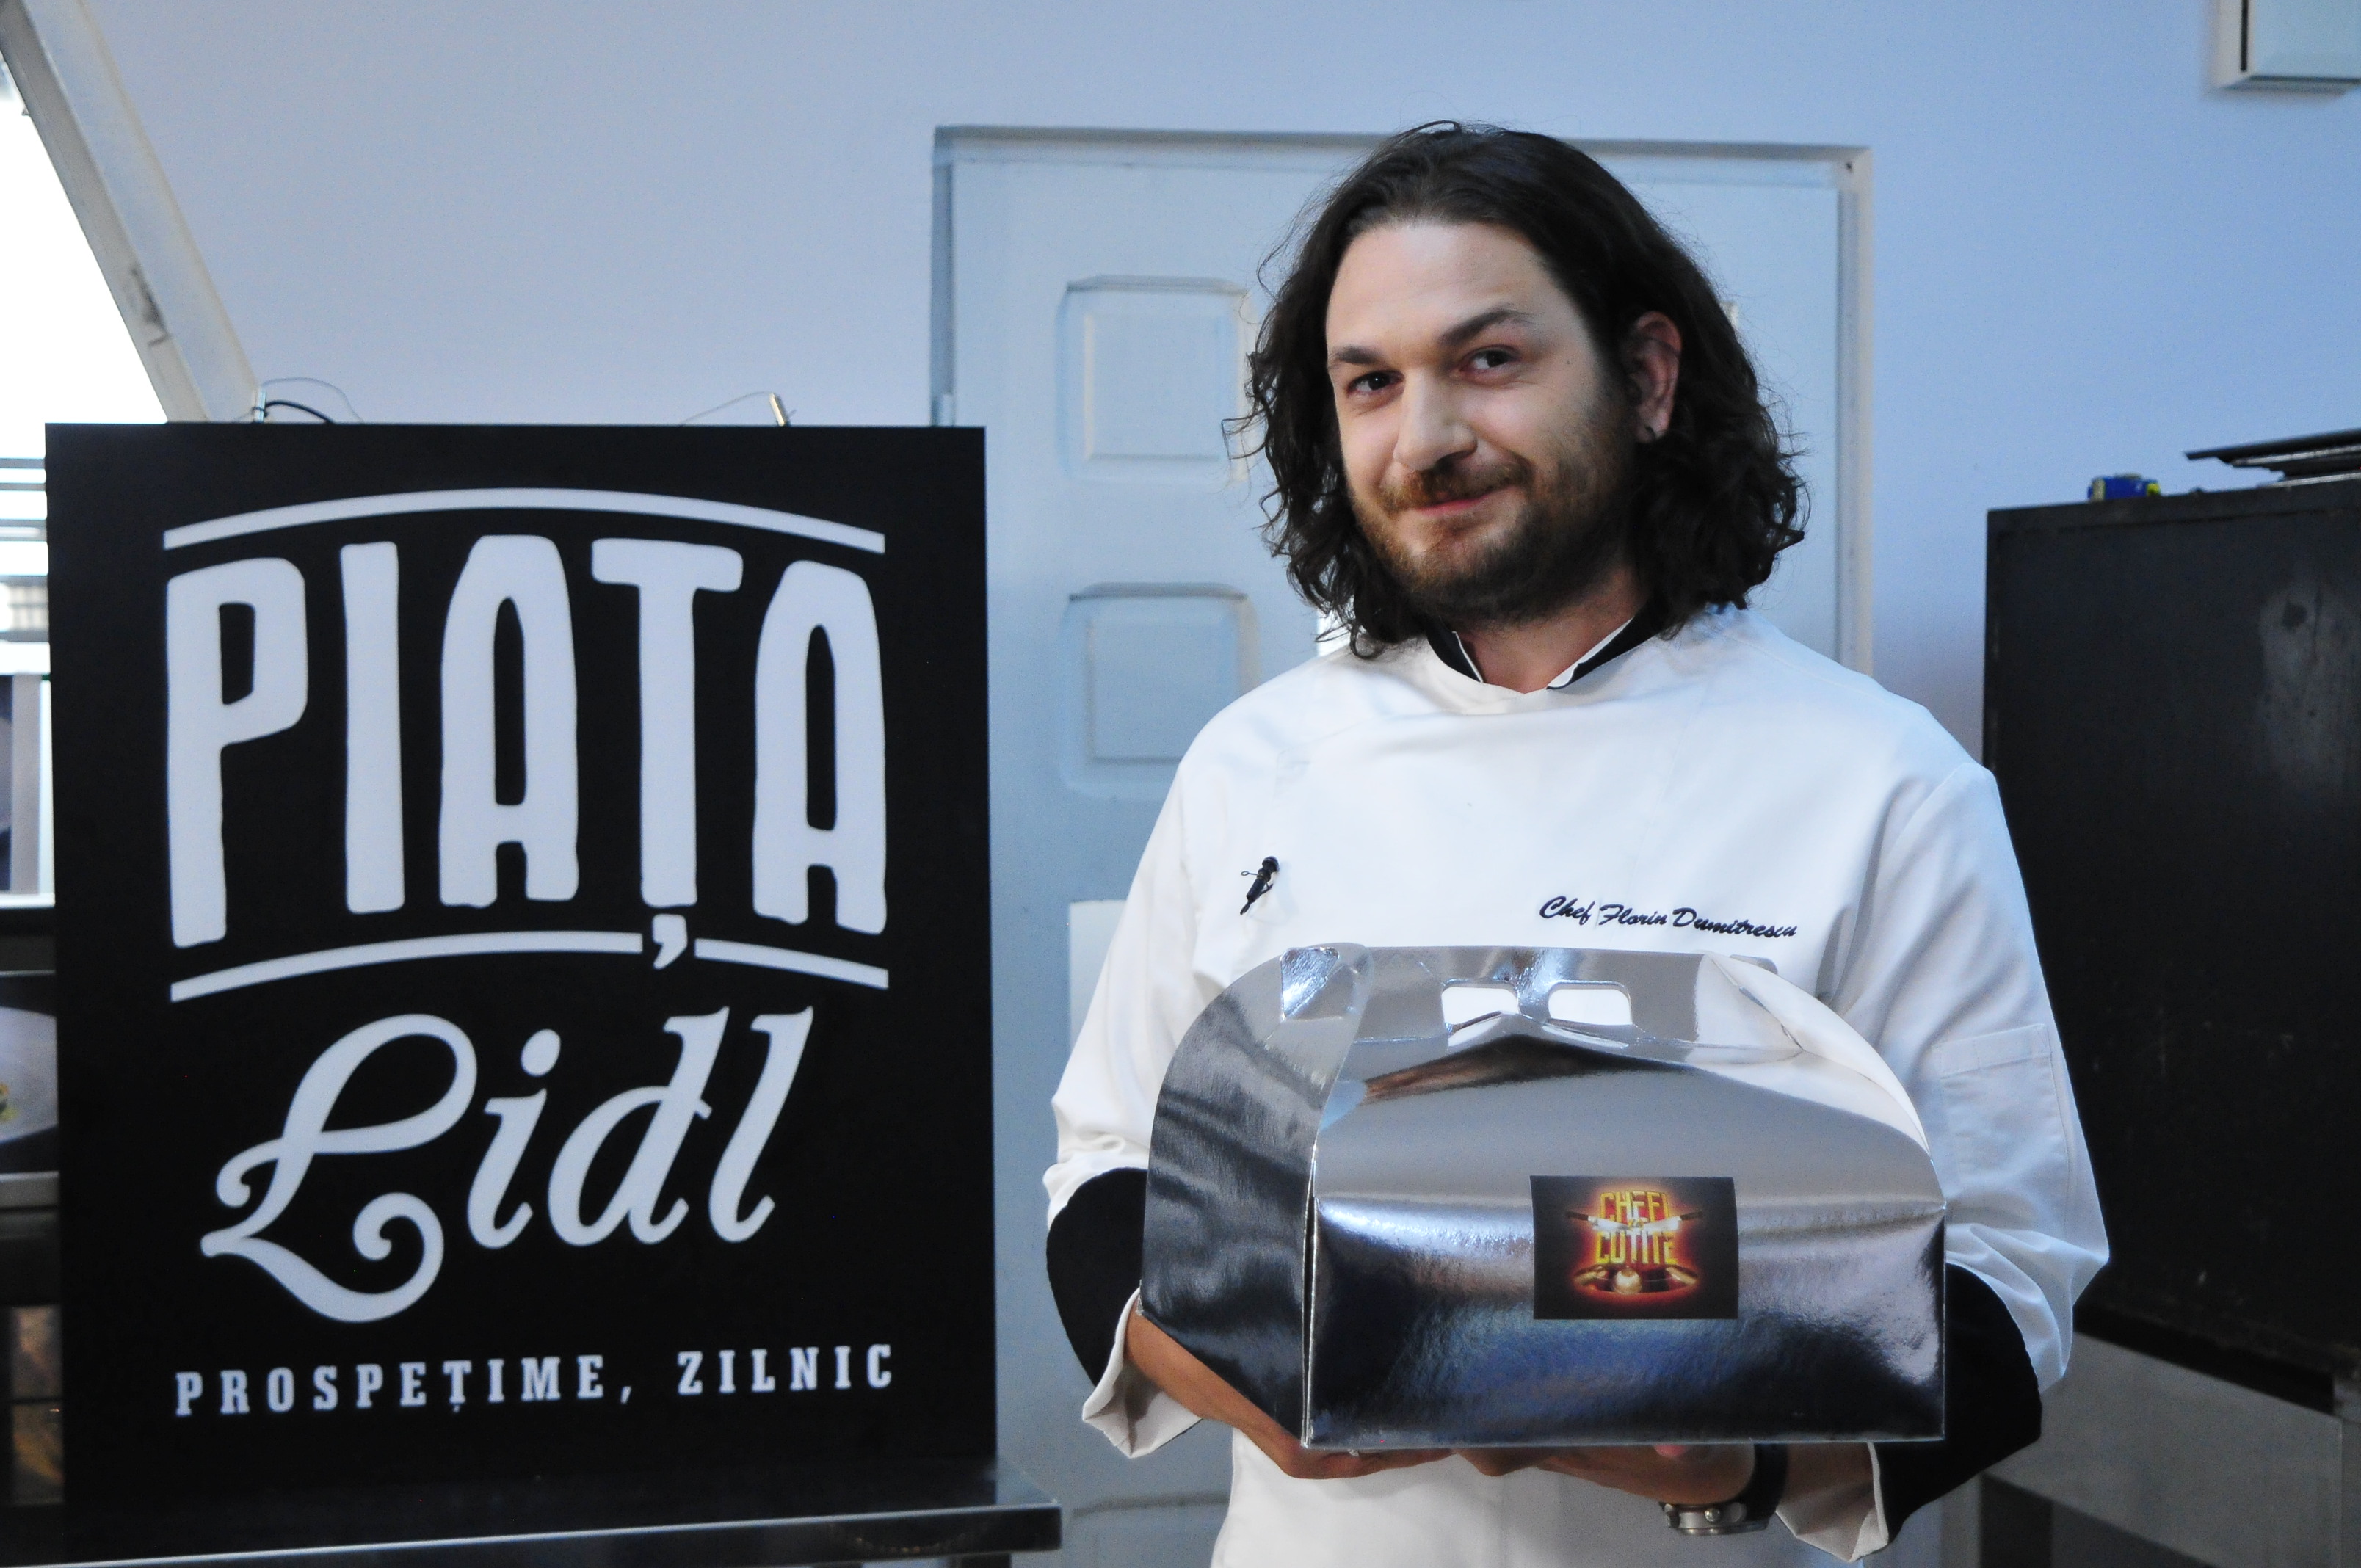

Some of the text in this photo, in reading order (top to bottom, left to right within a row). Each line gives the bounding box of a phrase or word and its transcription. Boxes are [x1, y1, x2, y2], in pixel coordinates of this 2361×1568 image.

[1539, 895, 1798, 939] Chef Florin Dumitrescu
[201, 1006, 813, 1321] Lidl
[1600, 1190, 1670, 1224] CHEFI
[678, 1344, 892, 1395] ZILNIC
